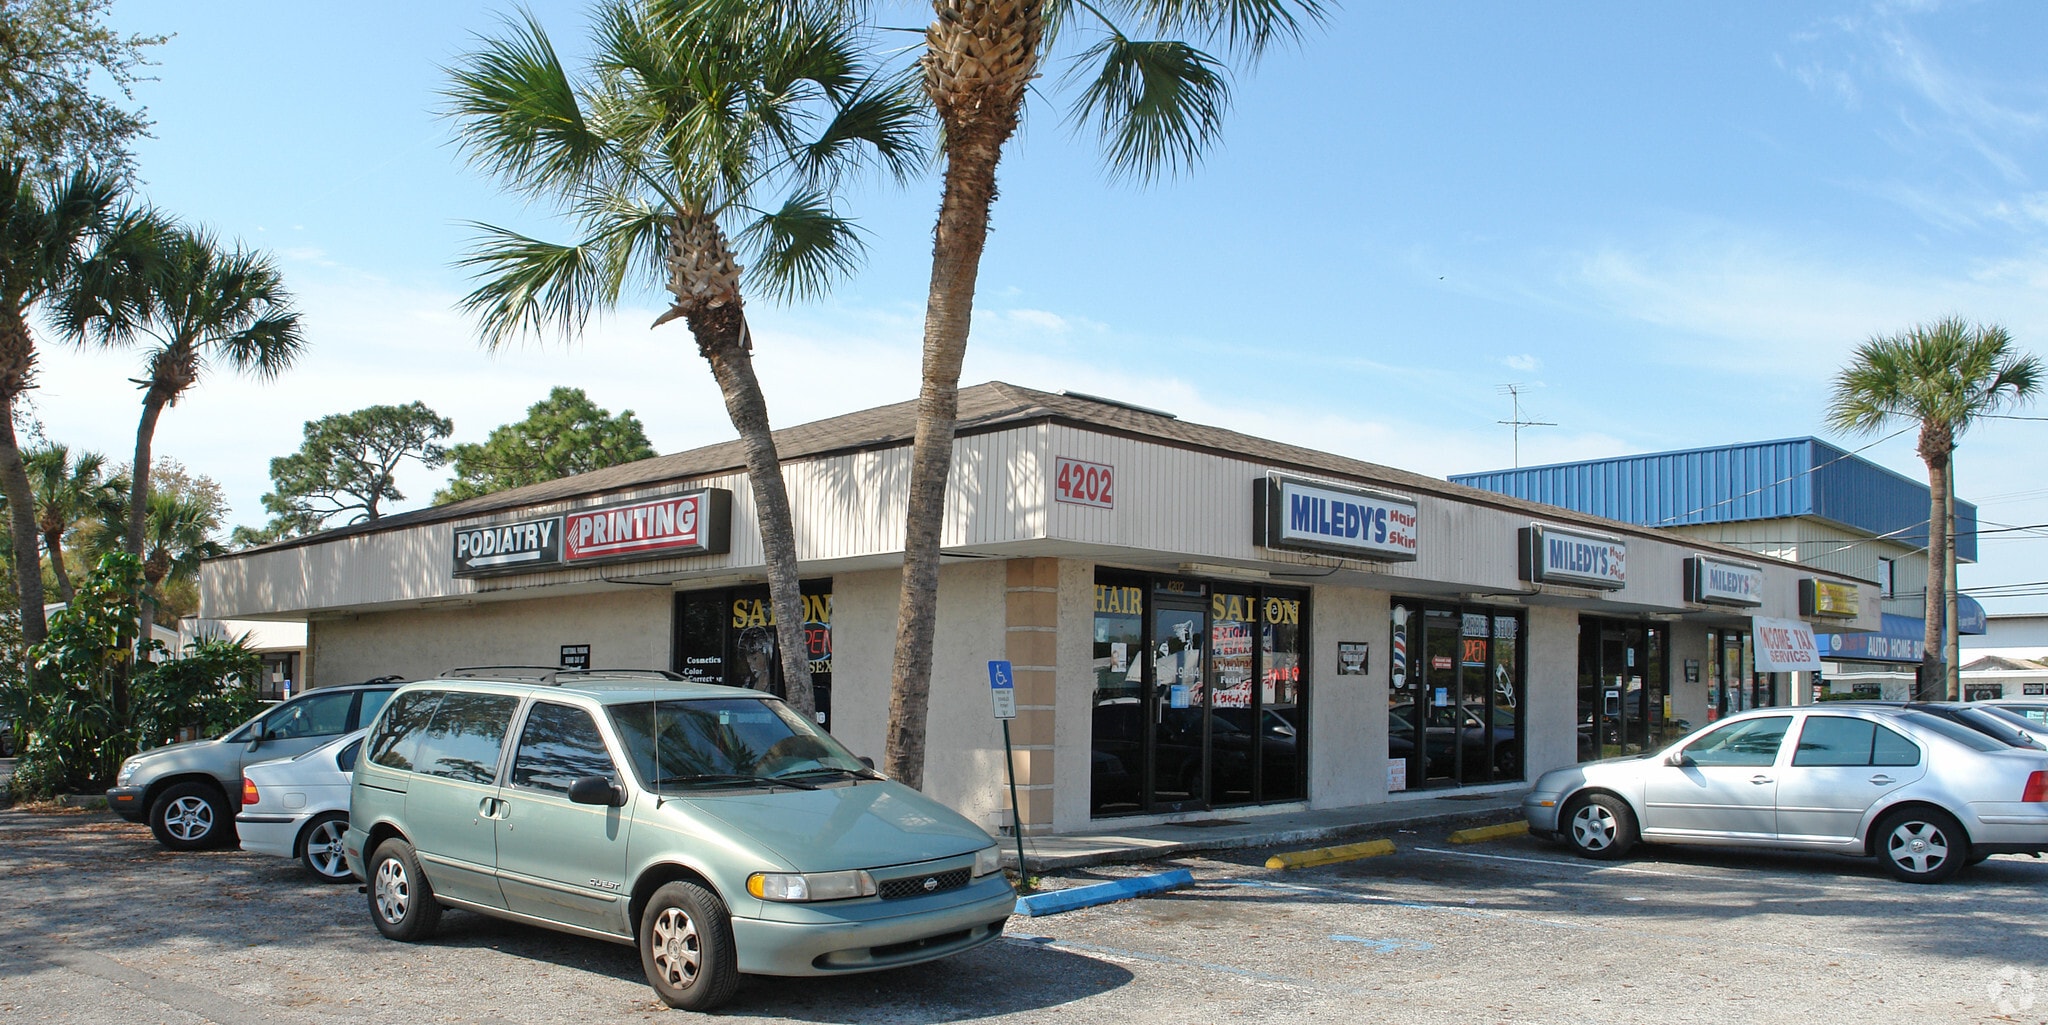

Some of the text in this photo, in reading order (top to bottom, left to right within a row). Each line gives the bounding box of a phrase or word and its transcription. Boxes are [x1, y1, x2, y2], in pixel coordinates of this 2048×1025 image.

[1058, 463, 1112, 504] 4202
[578, 500, 696, 547] PRINTING
[1291, 493, 1387, 544] MILEDY'S
[1390, 509, 1416, 527] Hair
[457, 521, 553, 558] PODIATRY
[1389, 531, 1416, 548] Skin
[1549, 539, 1608, 576] MILEDY'S
[1609, 546, 1625, 562] Hair
[1167, 580, 1184, 593] 4202
[1094, 584, 1143, 615] HAIR
[804, 629, 833, 654] PEN
[1760, 626, 1815, 650] INCOME TAX
[1868, 636, 1888, 657] AUTO
[1891, 638, 1912, 658] HOME
[1770, 650, 1811, 663] SERVICES
[590, 878, 621, 890] QUEST
